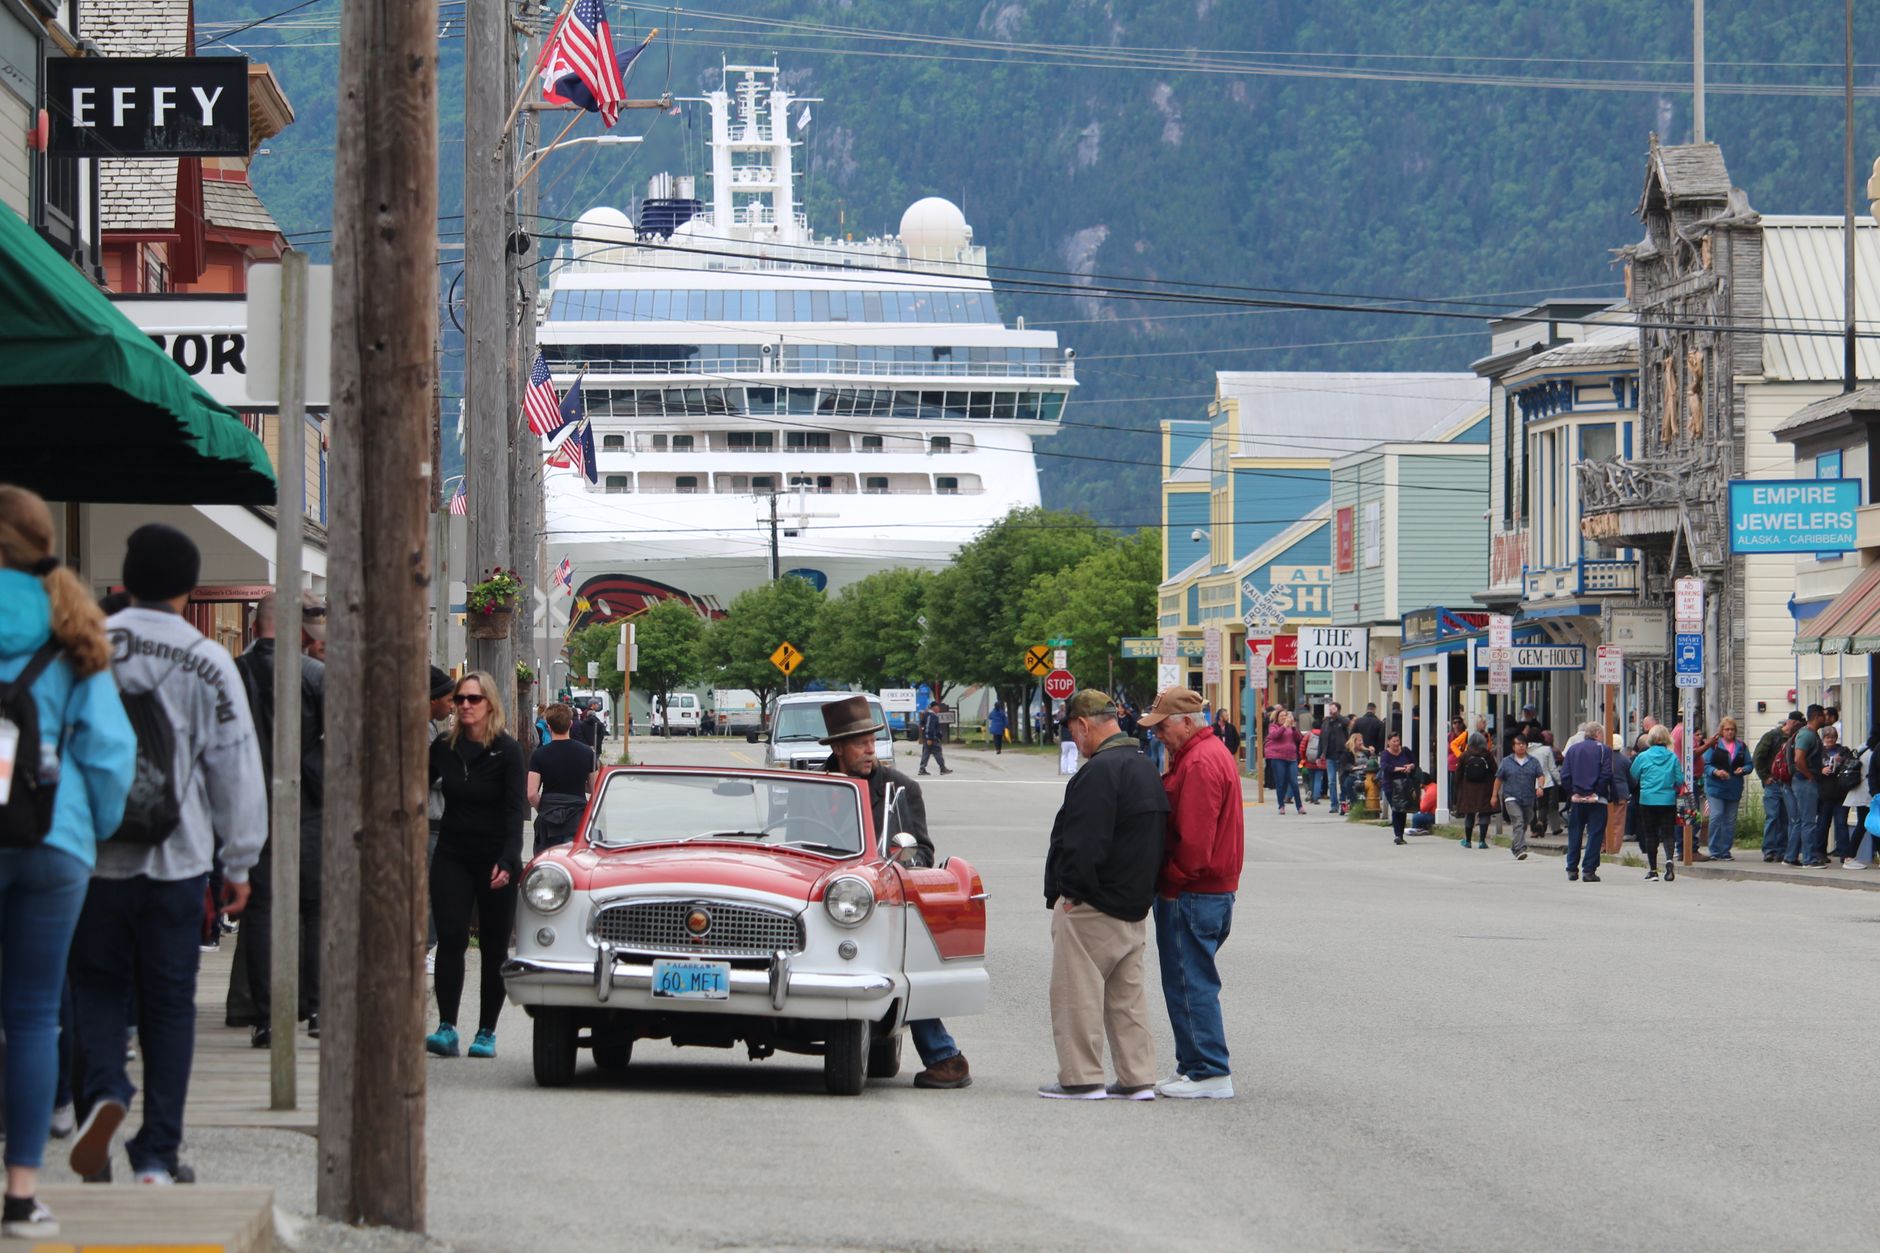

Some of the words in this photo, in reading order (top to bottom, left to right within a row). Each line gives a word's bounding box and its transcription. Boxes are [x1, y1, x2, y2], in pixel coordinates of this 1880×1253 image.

[72, 87, 224, 127] EFFY
[150, 334, 247, 376] OR
[1753, 487, 1836, 504] EMPIRE
[1736, 512, 1853, 530] JEWELERS
[1738, 535, 1780, 545] ALASKA
[1789, 534, 1853, 545] CARIBBEAN
[1313, 629, 1353, 646] THE
[1305, 650, 1360, 669] LOOM
[1047, 679, 1073, 690] STOP
[662, 972, 681, 990] 60
[691, 973, 721, 992] MET
